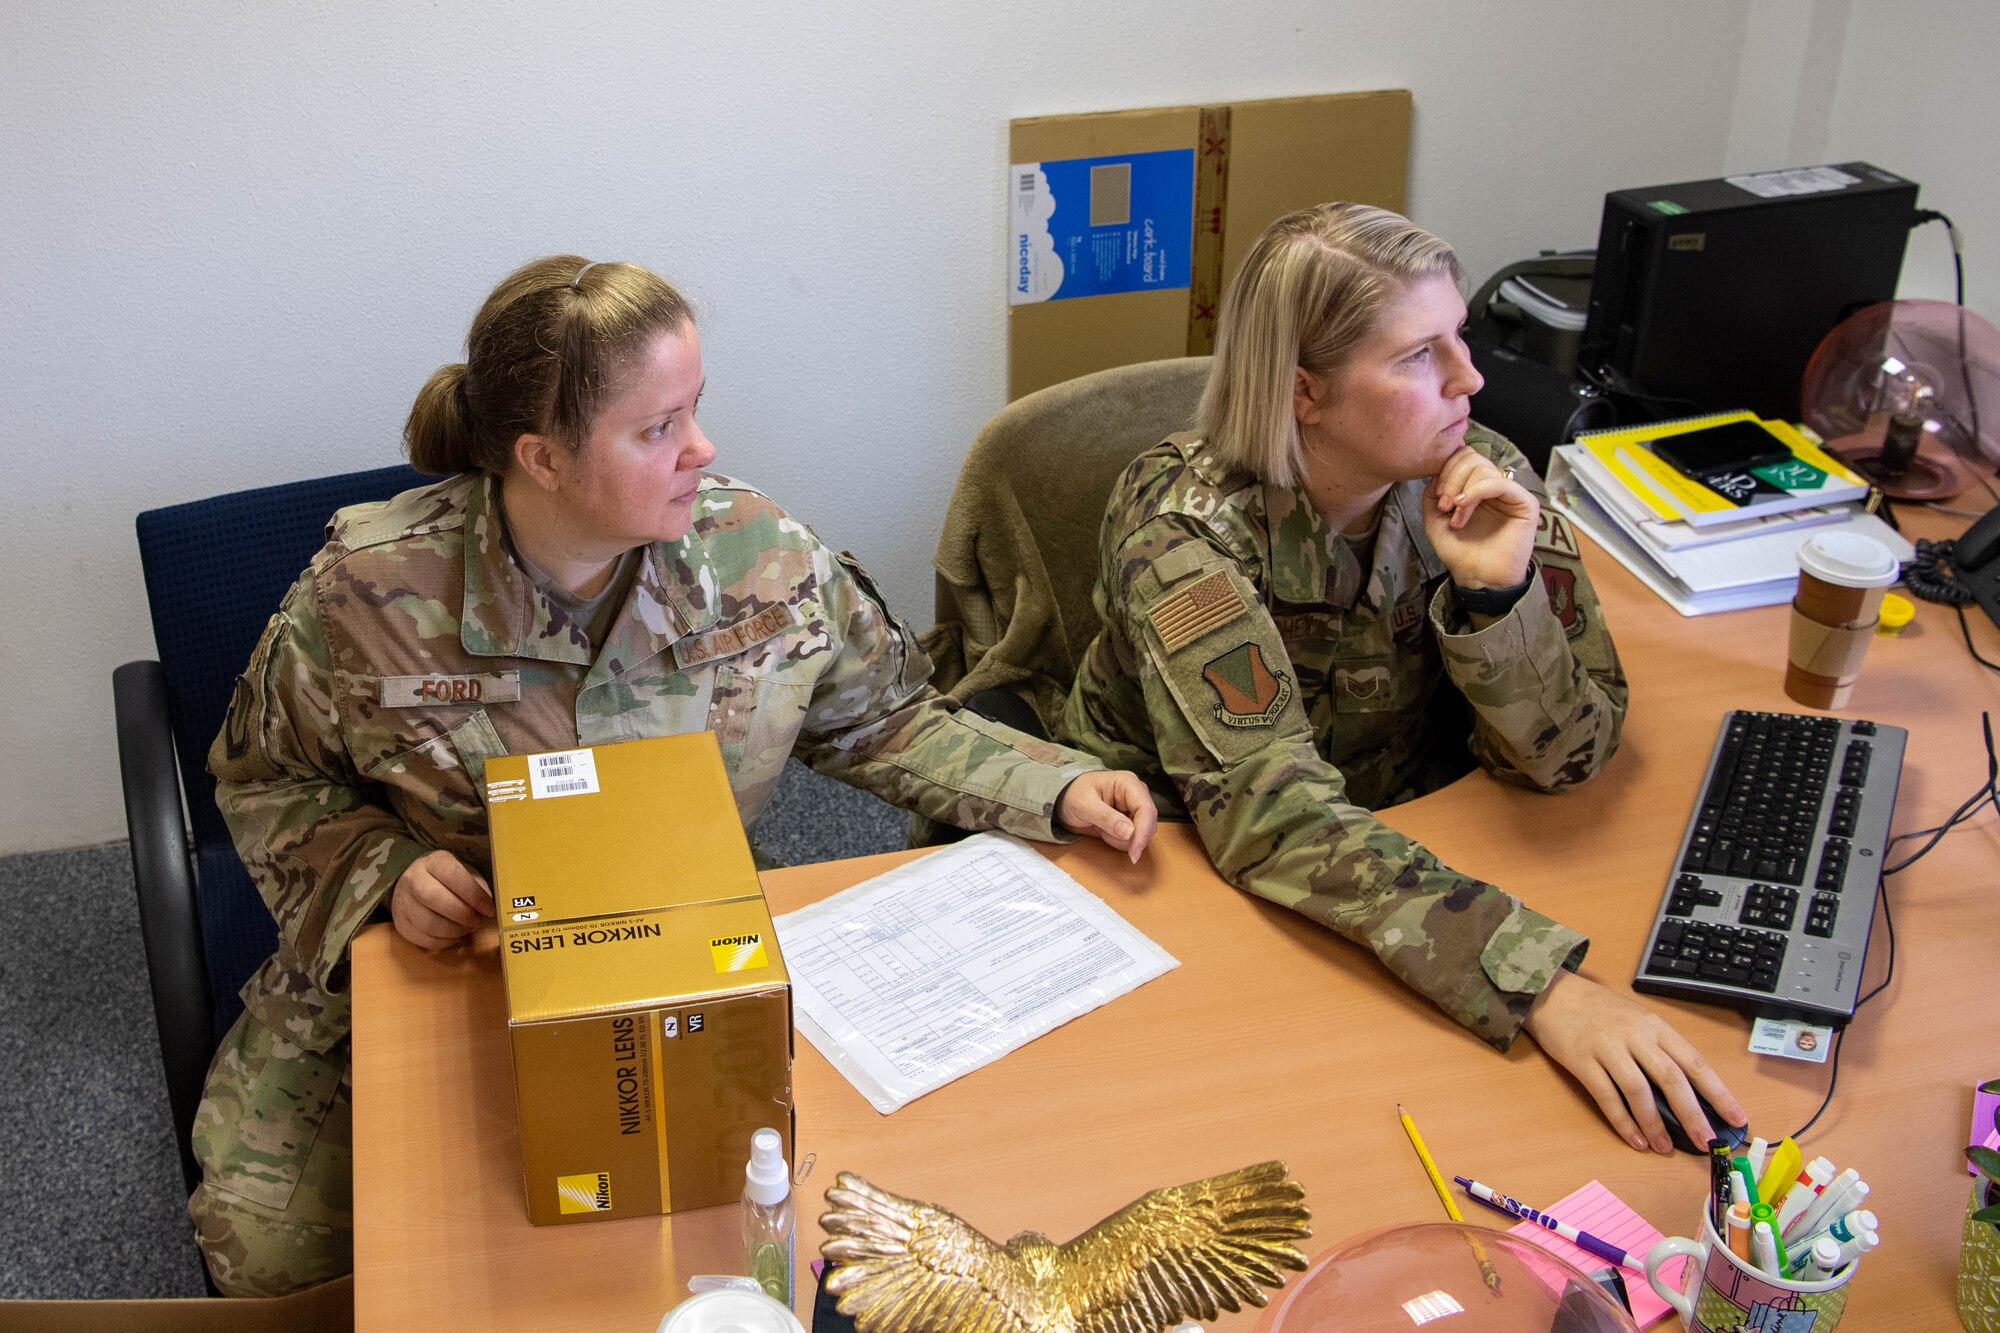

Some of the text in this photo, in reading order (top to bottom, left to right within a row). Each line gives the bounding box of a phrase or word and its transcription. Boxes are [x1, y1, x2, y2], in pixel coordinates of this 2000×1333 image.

[1017, 234, 1032, 293] niceday
[1142, 252, 1158, 283] board
[678, 606, 784, 664] U.S. AIR FORCE
[422, 679, 482, 702] FORD
[1228, 716, 1260, 725] VIRTUS
[514, 897, 534, 907] VR
[509, 923, 661, 954] NIKKOR LENS
[712, 934, 759, 948] Nikon
[690, 1015, 702, 1032] VR
[612, 1017, 641, 1135] NIKKOR LENS
[596, 1173, 611, 1209] Nikon
